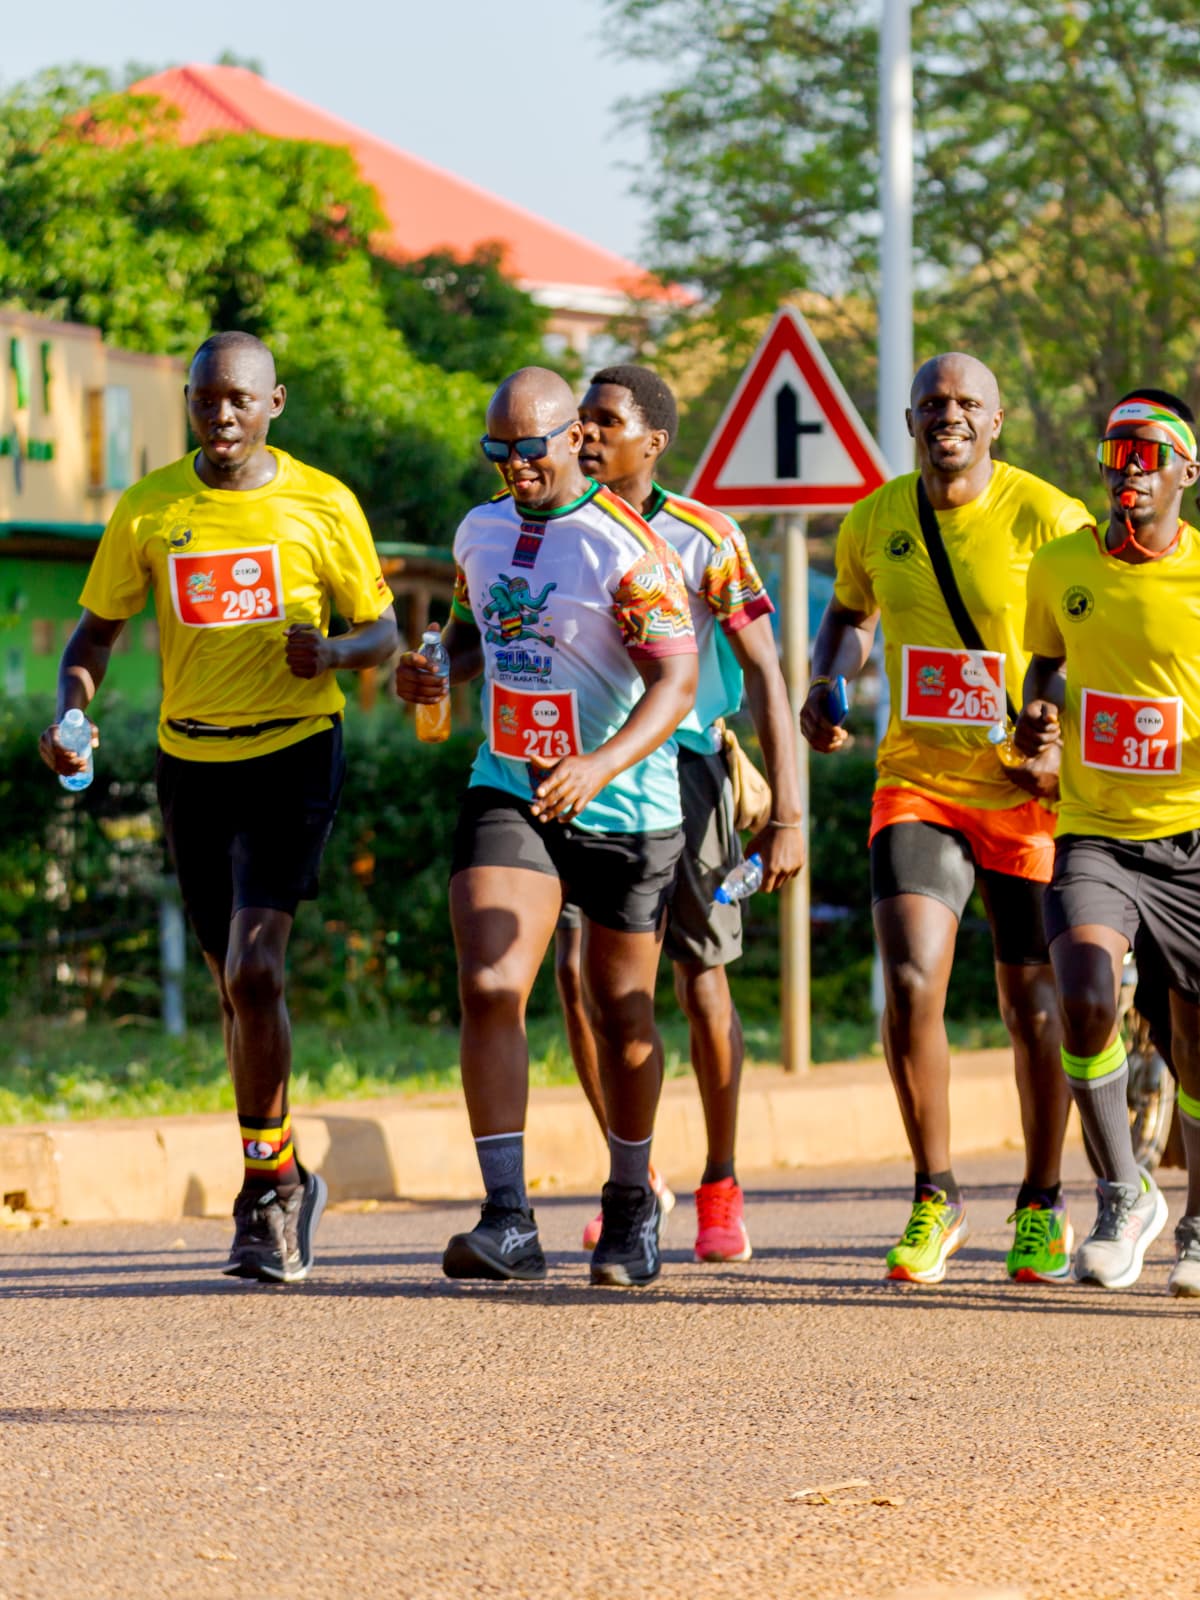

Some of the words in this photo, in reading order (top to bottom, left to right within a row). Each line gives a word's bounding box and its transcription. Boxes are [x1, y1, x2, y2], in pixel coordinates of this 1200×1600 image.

[234, 568, 259, 576] 21KM
[221, 587, 273, 619] 293
[948, 687, 997, 719] 265
[1136, 717, 1163, 725] 21KM
[523, 729, 571, 757] 273
[1122, 736, 1169, 769] 317
